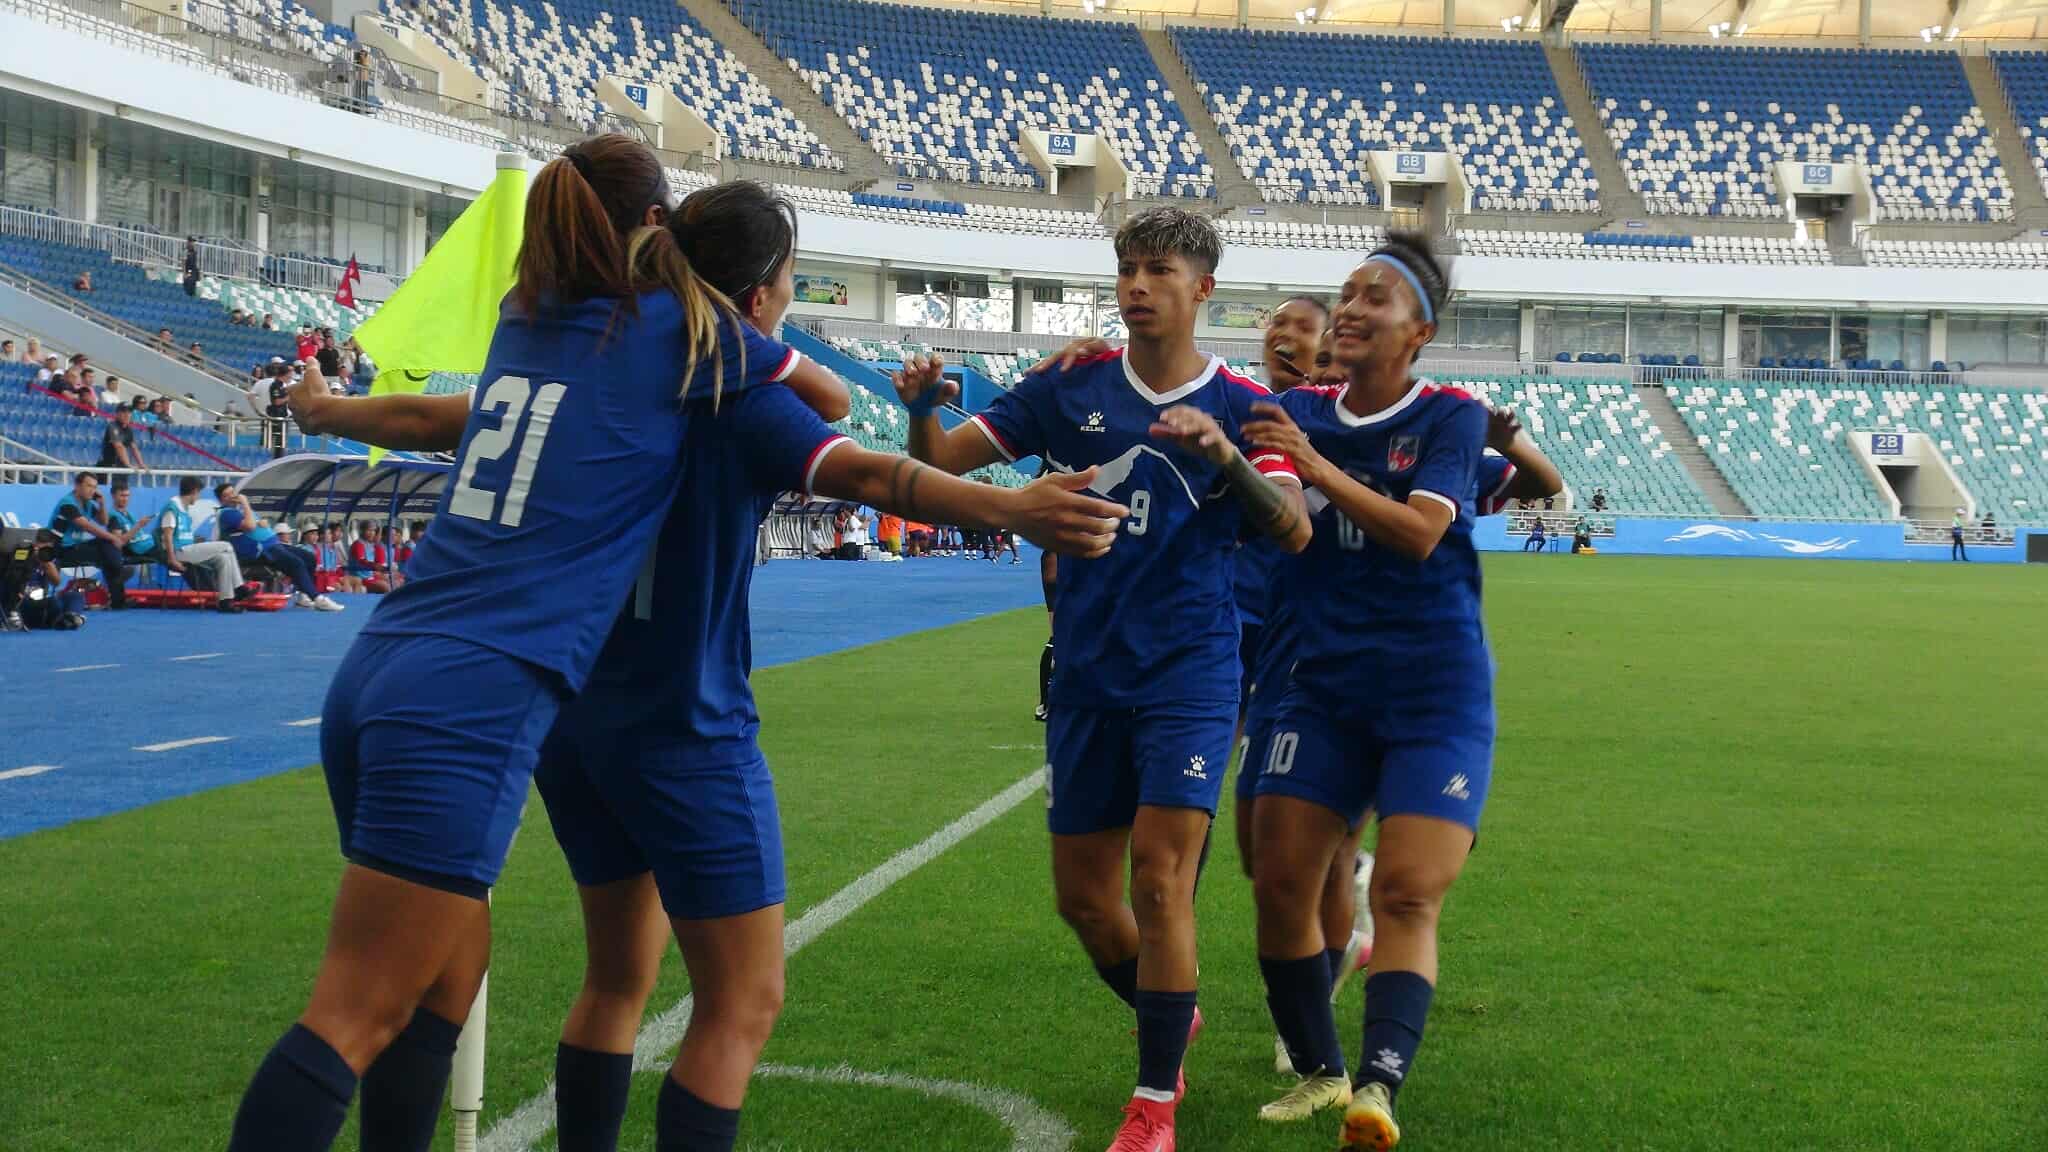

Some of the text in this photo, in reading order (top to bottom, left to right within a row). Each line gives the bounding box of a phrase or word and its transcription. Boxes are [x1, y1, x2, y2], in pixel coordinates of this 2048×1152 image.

[1053, 136, 1071, 148] 6A
[1402, 155, 1420, 167] 6B
[1809, 166, 1826, 178] 6C
[1080, 425, 1106, 433] KELME
[1877, 435, 1898, 448] 2B
[448, 375, 568, 527] 21
[1127, 489, 1151, 536] 9
[1264, 731, 1300, 775] 10
[1183, 768, 1208, 780] KELME
